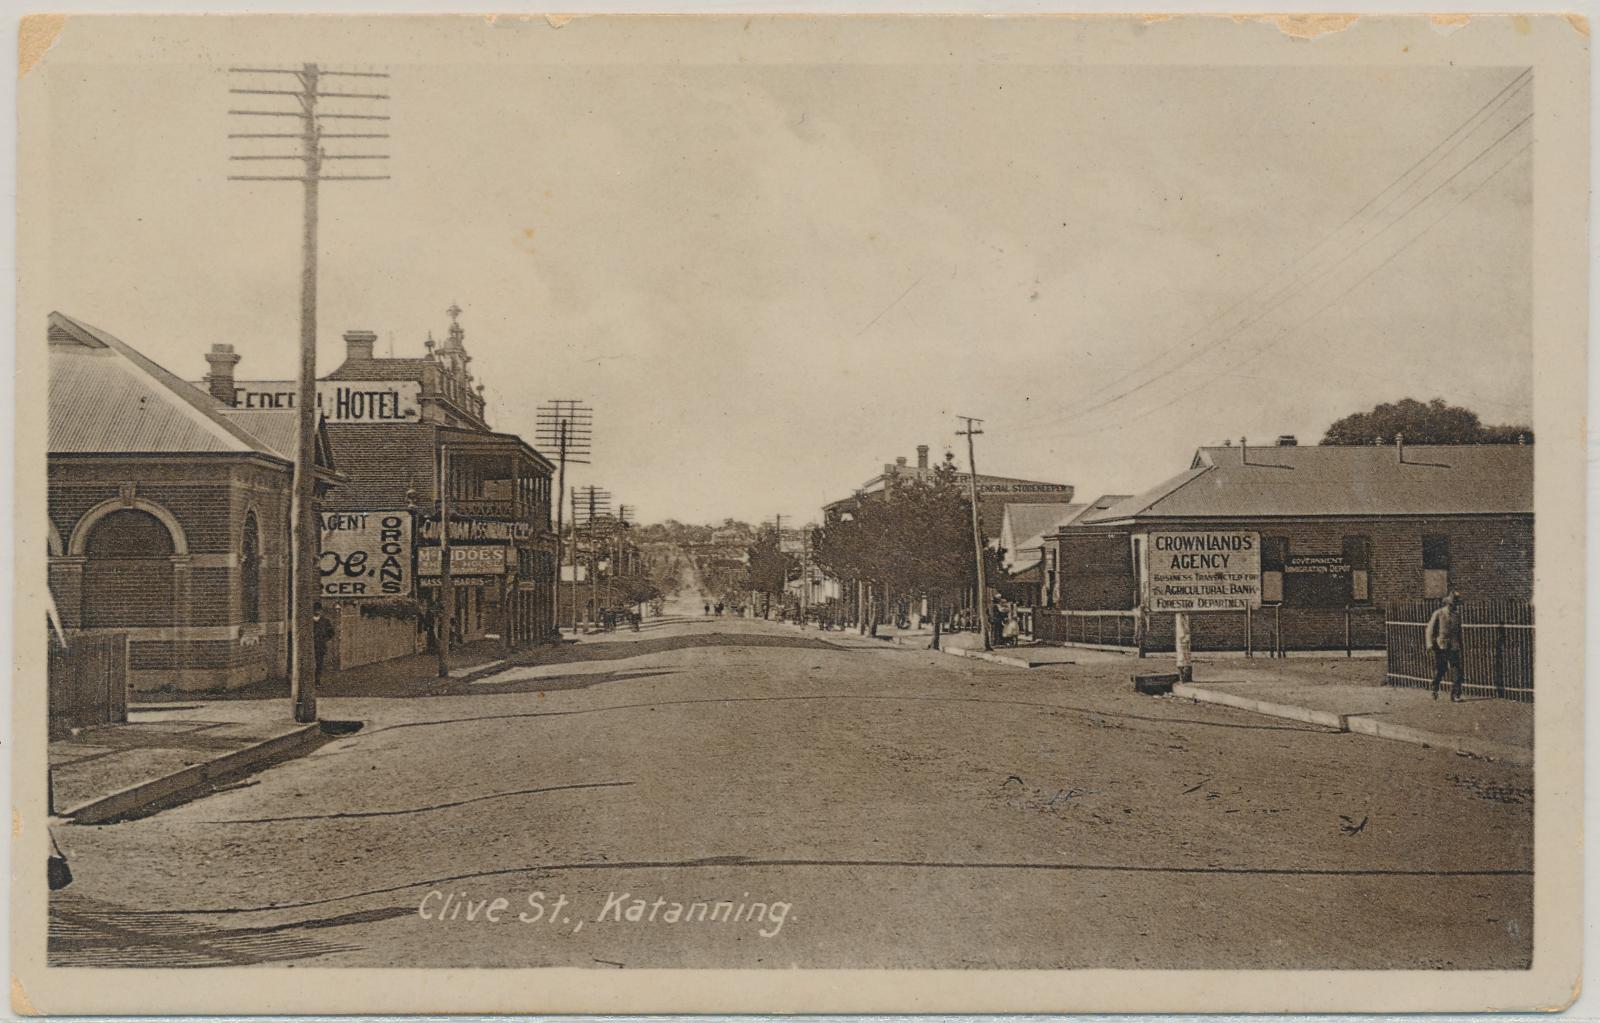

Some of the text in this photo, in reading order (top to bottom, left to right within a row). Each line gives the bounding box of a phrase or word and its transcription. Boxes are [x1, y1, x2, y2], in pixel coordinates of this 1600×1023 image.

[336, 386, 406, 419] HOTEL
[380, 516, 403, 593] ORGANS
[1171, 554, 1230, 569] AGENCY
[1165, 584, 1228, 595] AGRICULTURAL
[1230, 584, 1256, 595] BANK
